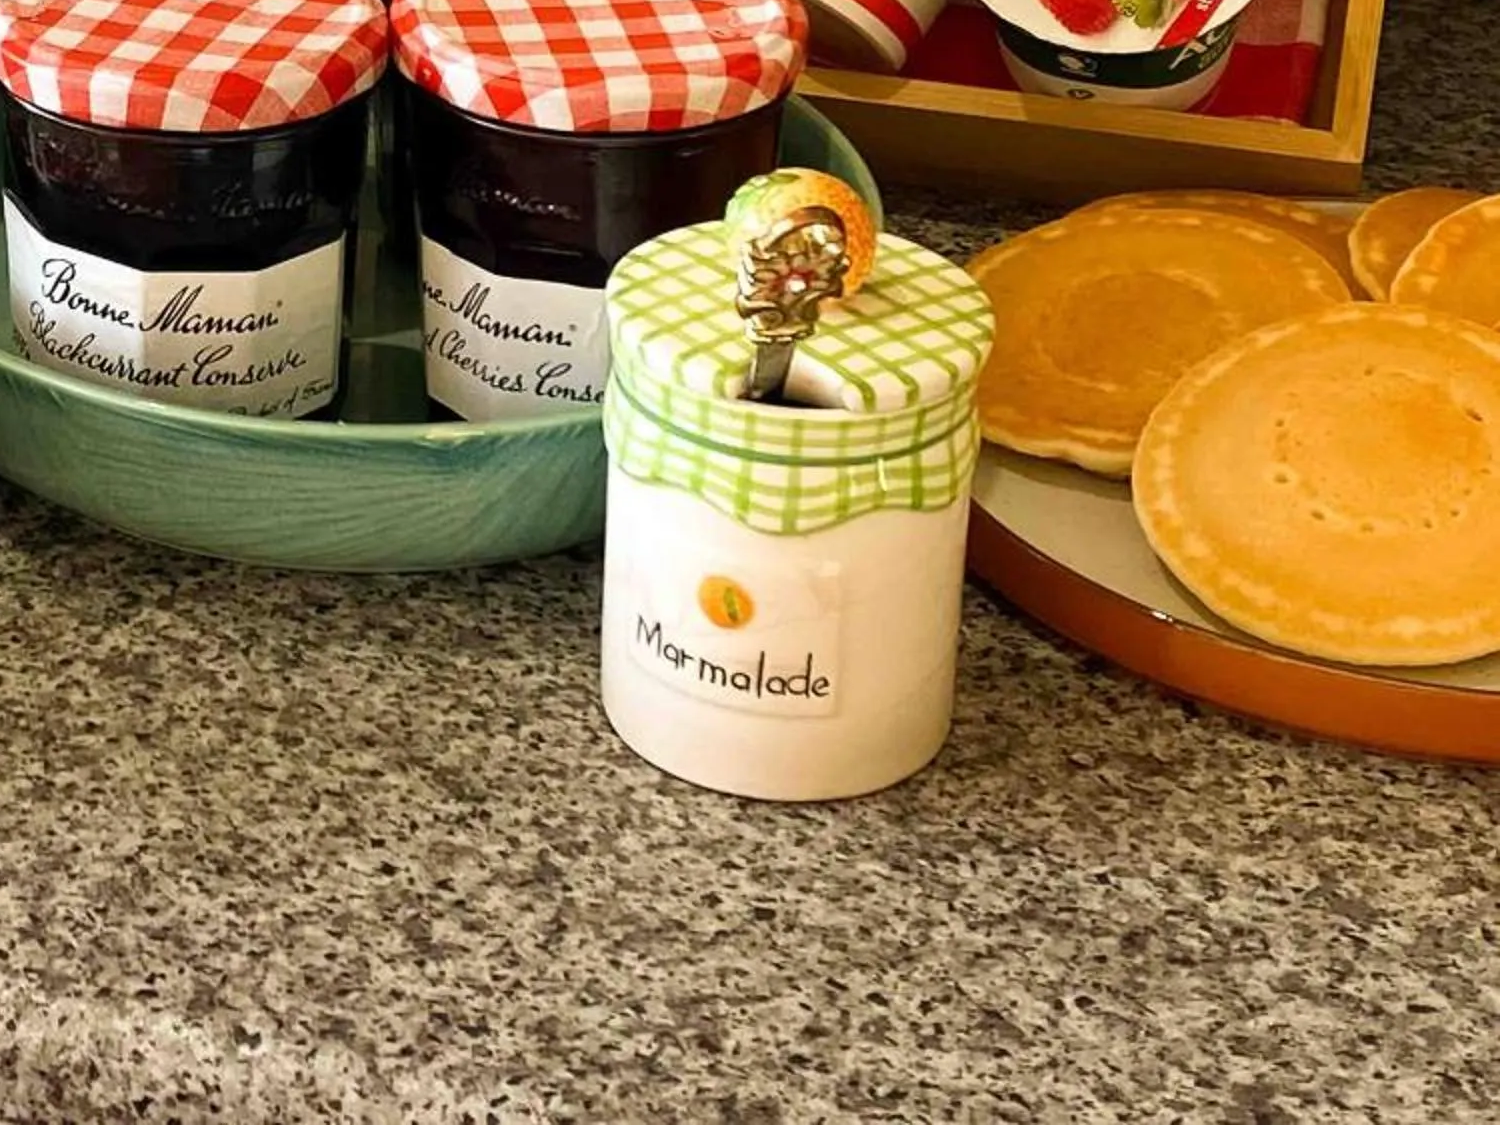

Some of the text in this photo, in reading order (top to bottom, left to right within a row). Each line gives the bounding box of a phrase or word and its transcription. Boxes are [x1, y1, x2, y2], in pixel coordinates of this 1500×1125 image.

[41, 257, 279, 335] Bonne Maman
[449, 281, 573, 348] Maman
[28, 299, 189, 389] Blackcurrant
[191, 343, 308, 388] Conserve
[438, 329, 529, 393] Cherries
[534, 361, 606, 404] Conse
[636, 613, 832, 701] Marmalade
